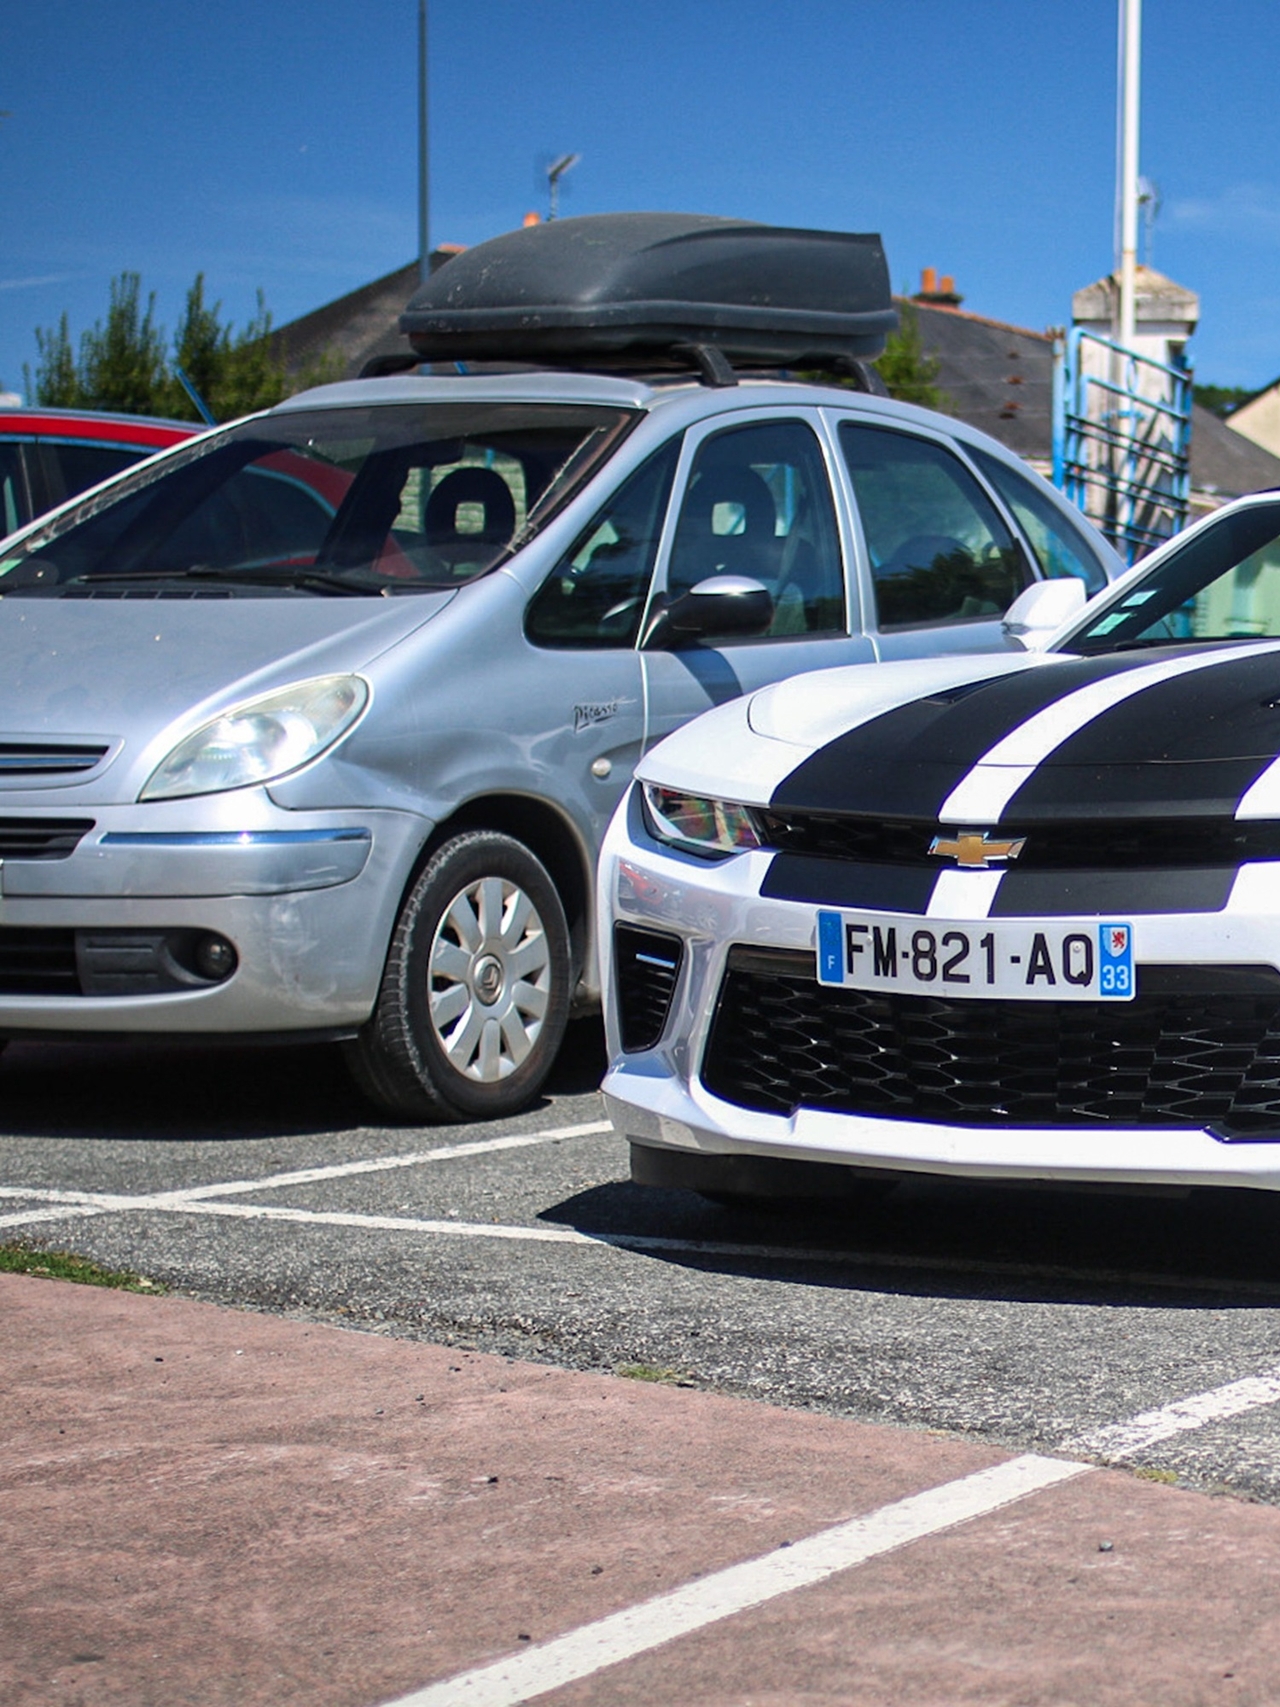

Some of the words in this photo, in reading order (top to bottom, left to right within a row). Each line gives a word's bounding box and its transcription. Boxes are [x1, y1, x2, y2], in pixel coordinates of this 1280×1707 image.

[827, 957, 836, 970] F
[846, 924, 1093, 987] FM-821-AQ
[1102, 965, 1129, 990] 33
